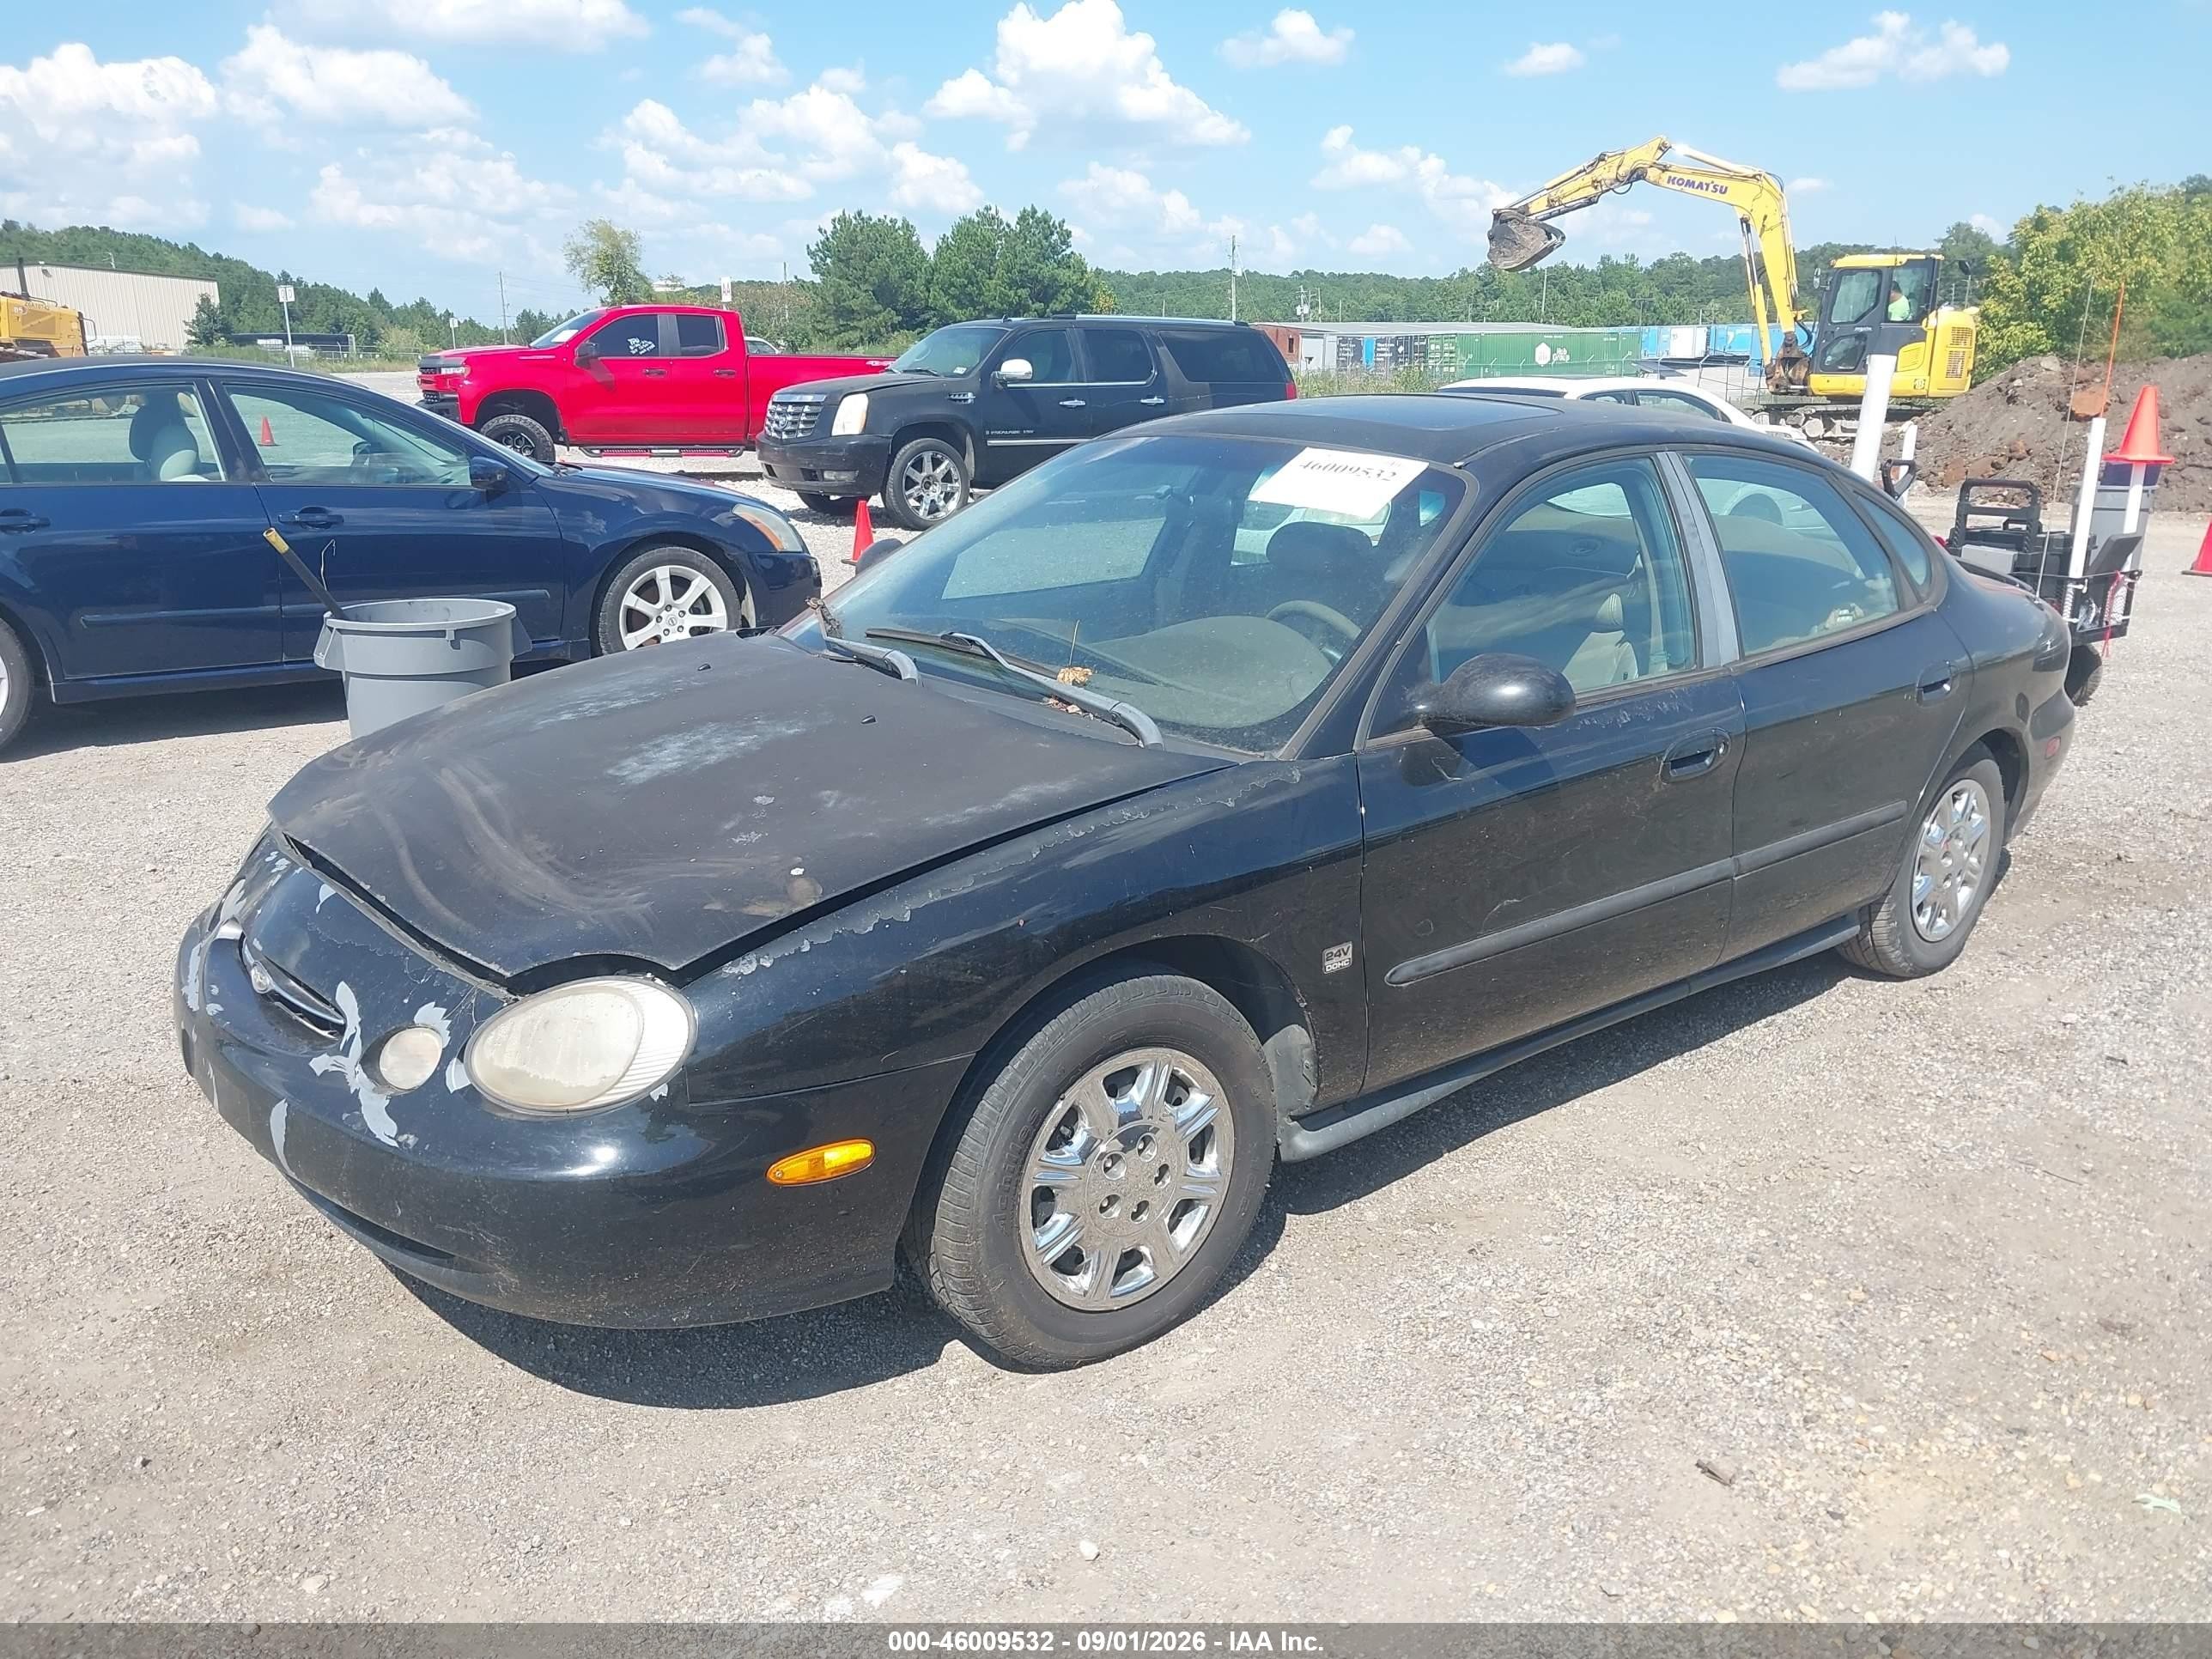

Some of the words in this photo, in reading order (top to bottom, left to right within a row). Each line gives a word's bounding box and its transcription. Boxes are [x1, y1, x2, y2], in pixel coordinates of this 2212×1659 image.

[1667, 175, 1729, 195] KOMATSU
[1298, 459, 1398, 482] 46009532
[1325, 945, 1351, 962] 24V
[1325, 957, 1351, 972] DOHC
